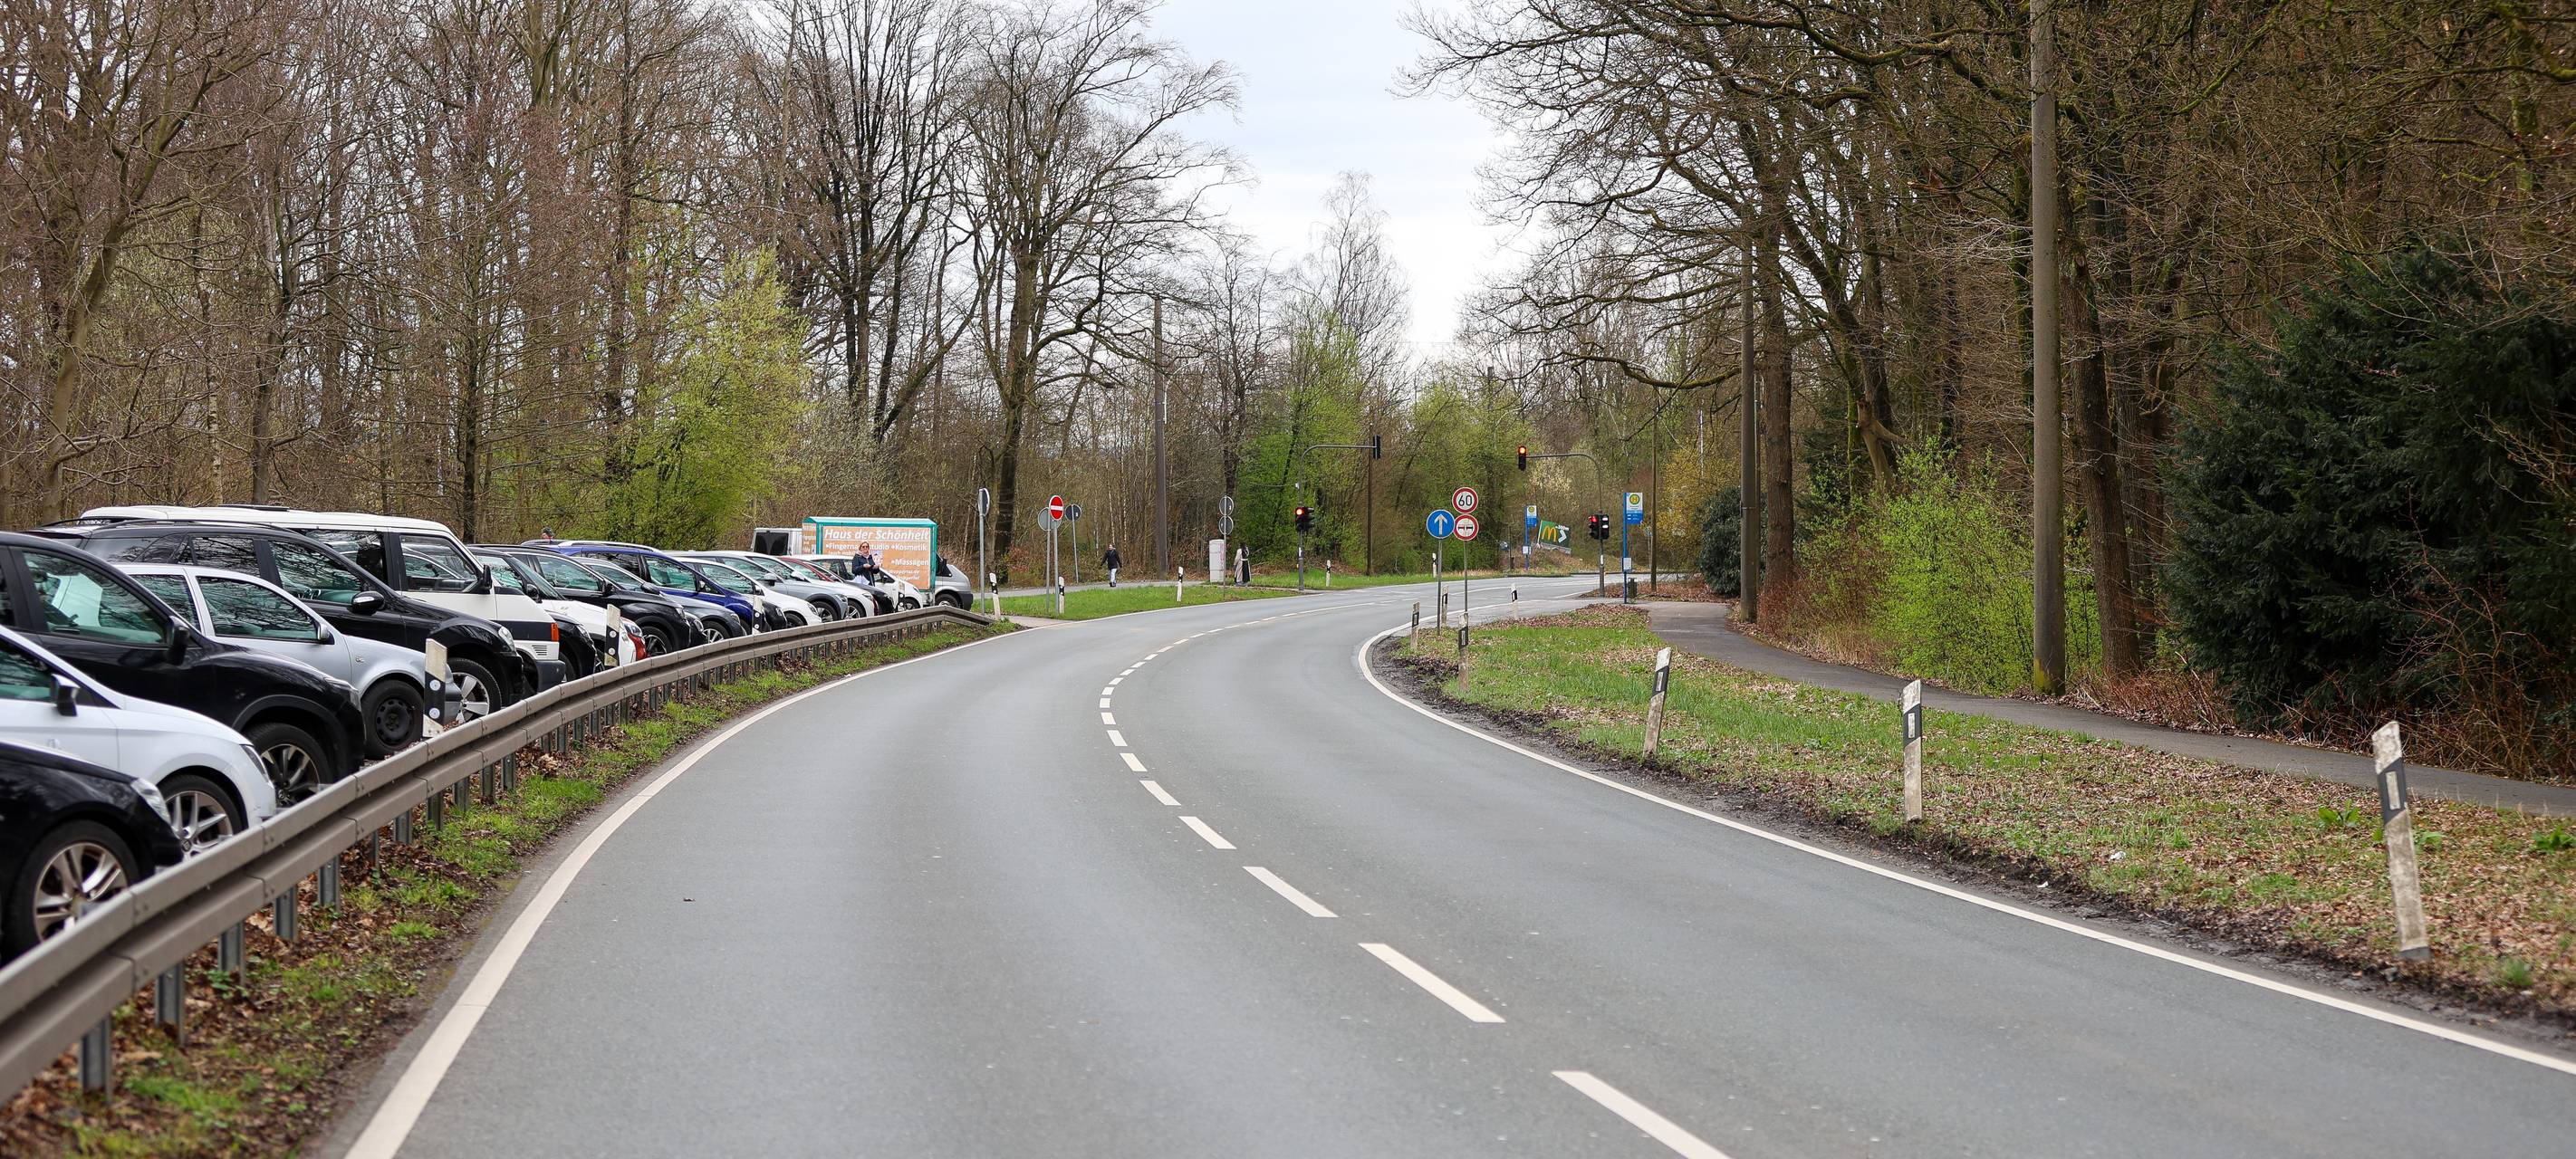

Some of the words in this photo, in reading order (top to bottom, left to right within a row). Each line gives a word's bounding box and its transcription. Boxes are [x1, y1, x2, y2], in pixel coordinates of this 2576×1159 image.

[1458, 494, 1473, 507] 60
[824, 529, 851, 540] Haus
[855, 529, 871, 540] der
[875, 529, 929, 541] Schönheit
[895, 543, 928, 551] Kosmetik
[895, 558, 929, 567] Massagen
